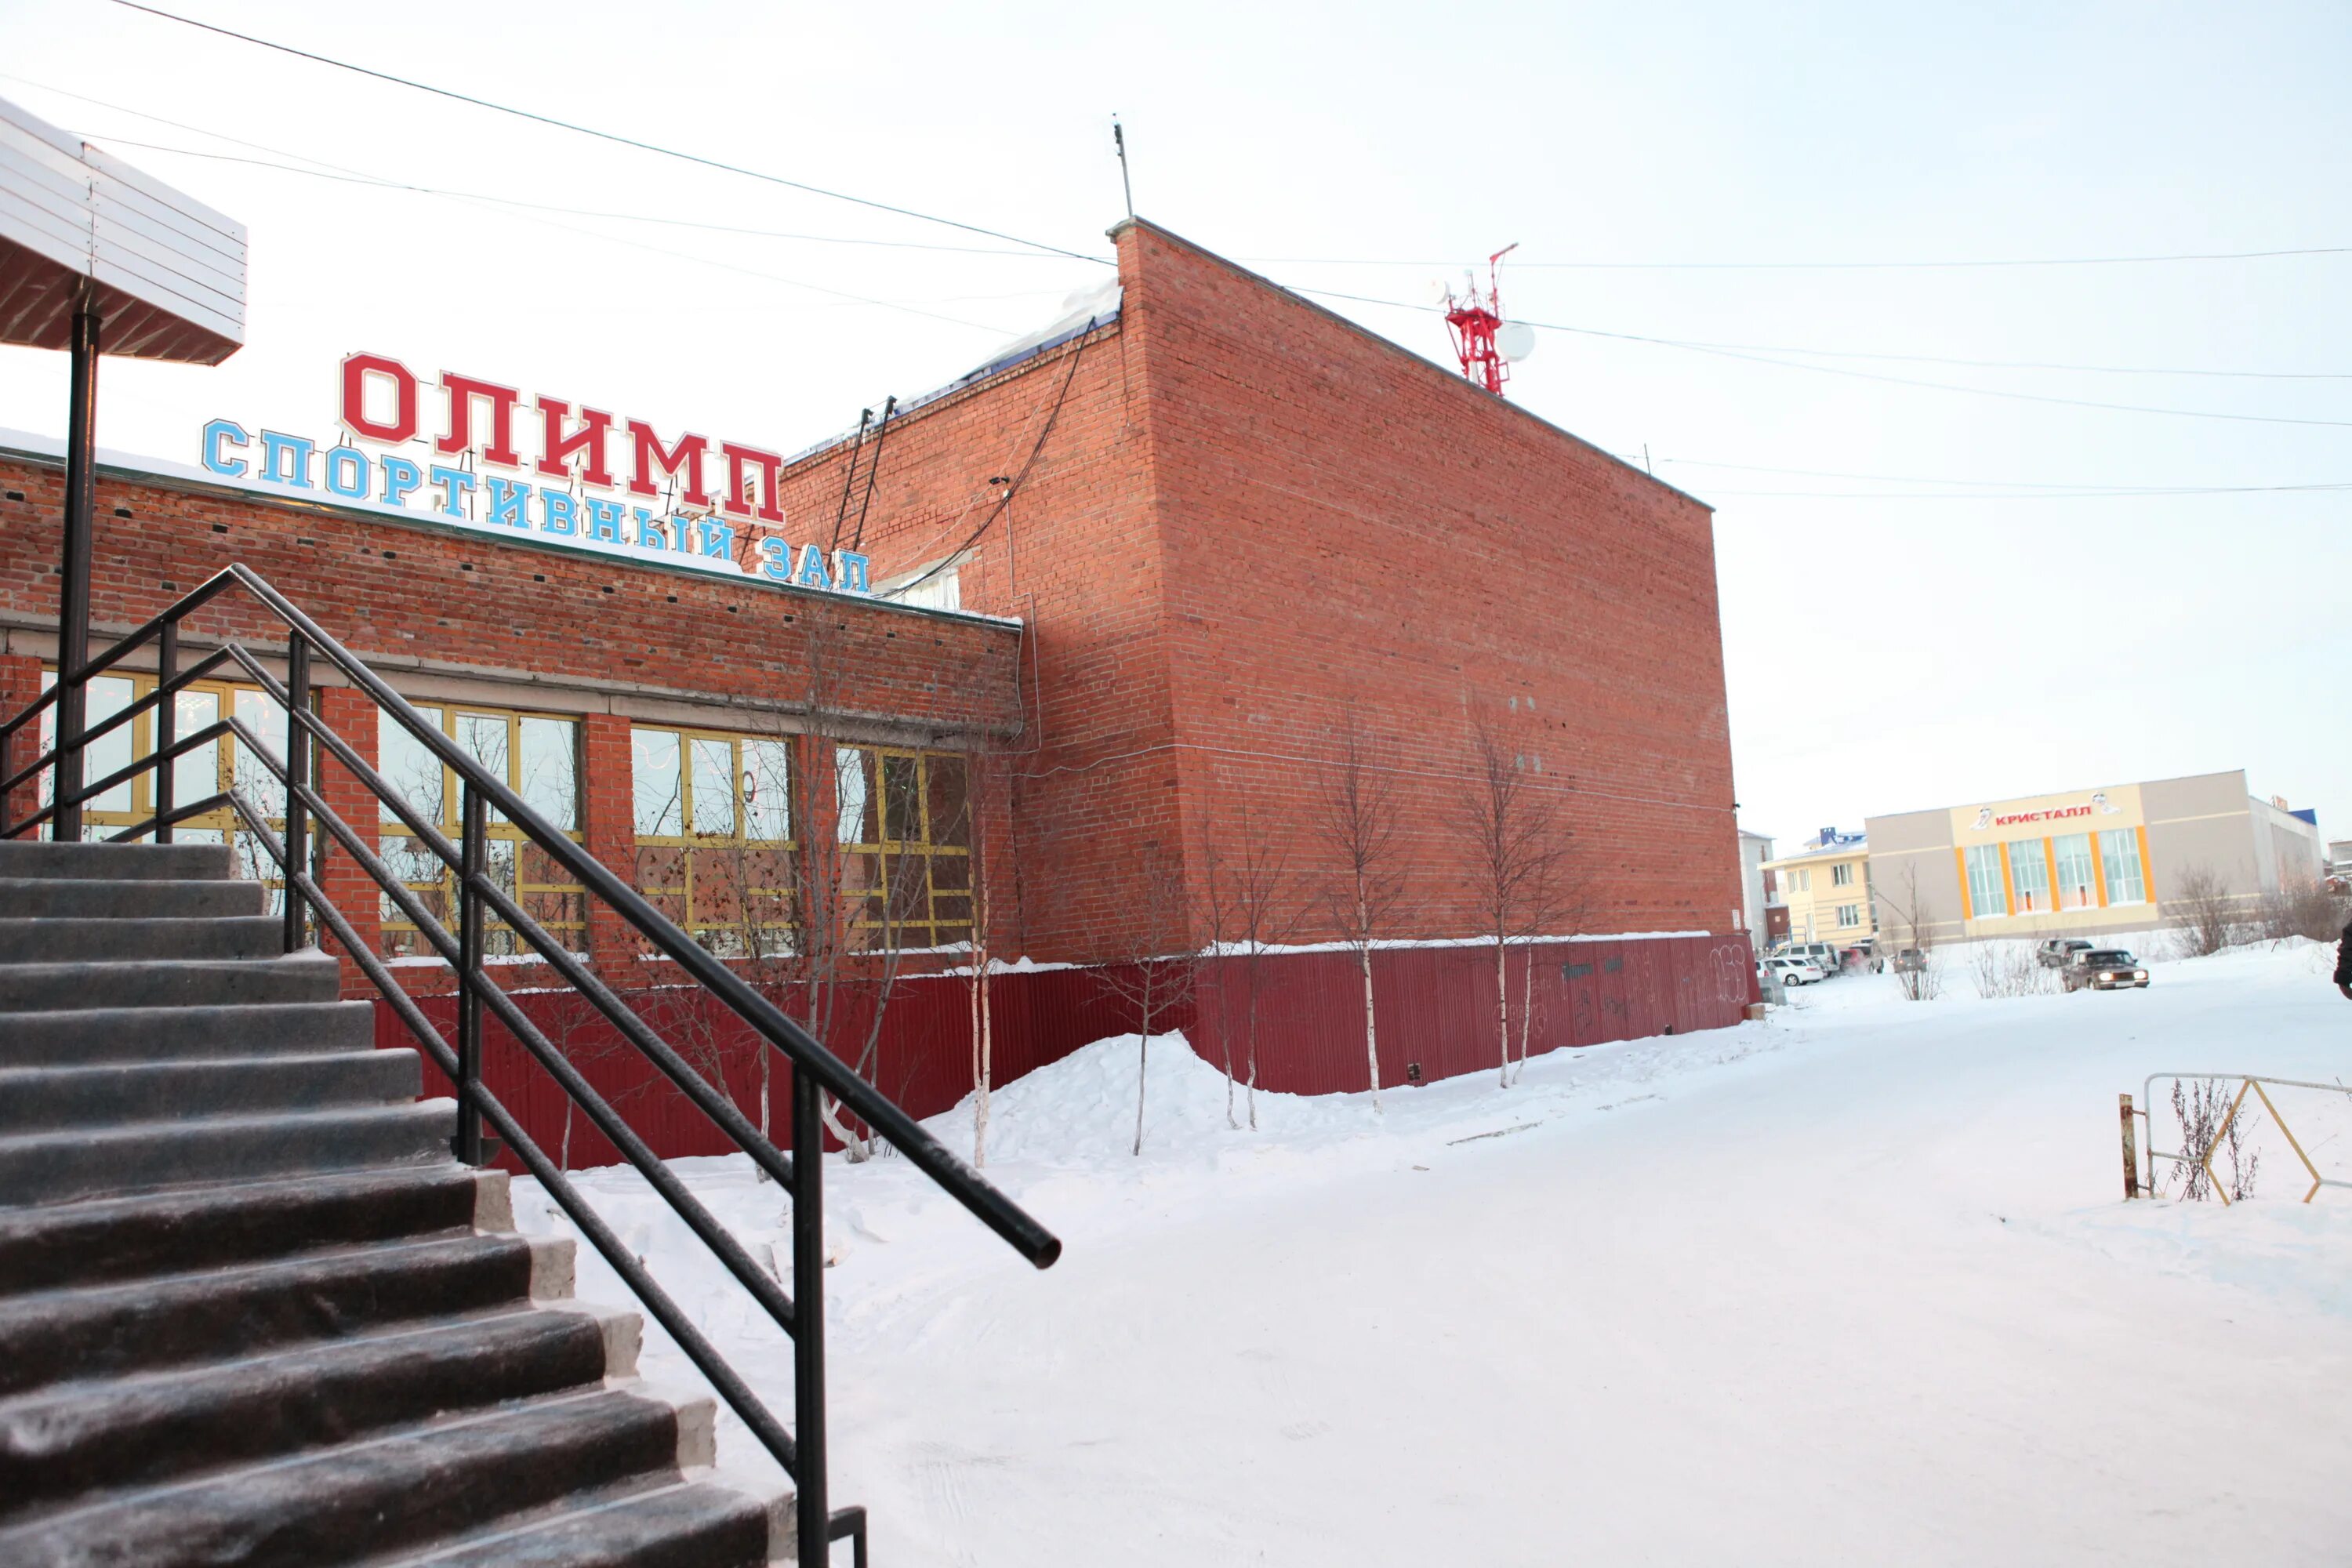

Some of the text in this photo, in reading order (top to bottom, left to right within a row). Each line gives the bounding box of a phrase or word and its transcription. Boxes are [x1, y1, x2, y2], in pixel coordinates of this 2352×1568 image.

[201, 418, 870, 593] СПОРТИВНЫЙ ЗАЛ
[339, 350, 785, 527] ОЛИМП
[1996, 806, 2092, 826] КРИСТАЛЛ
